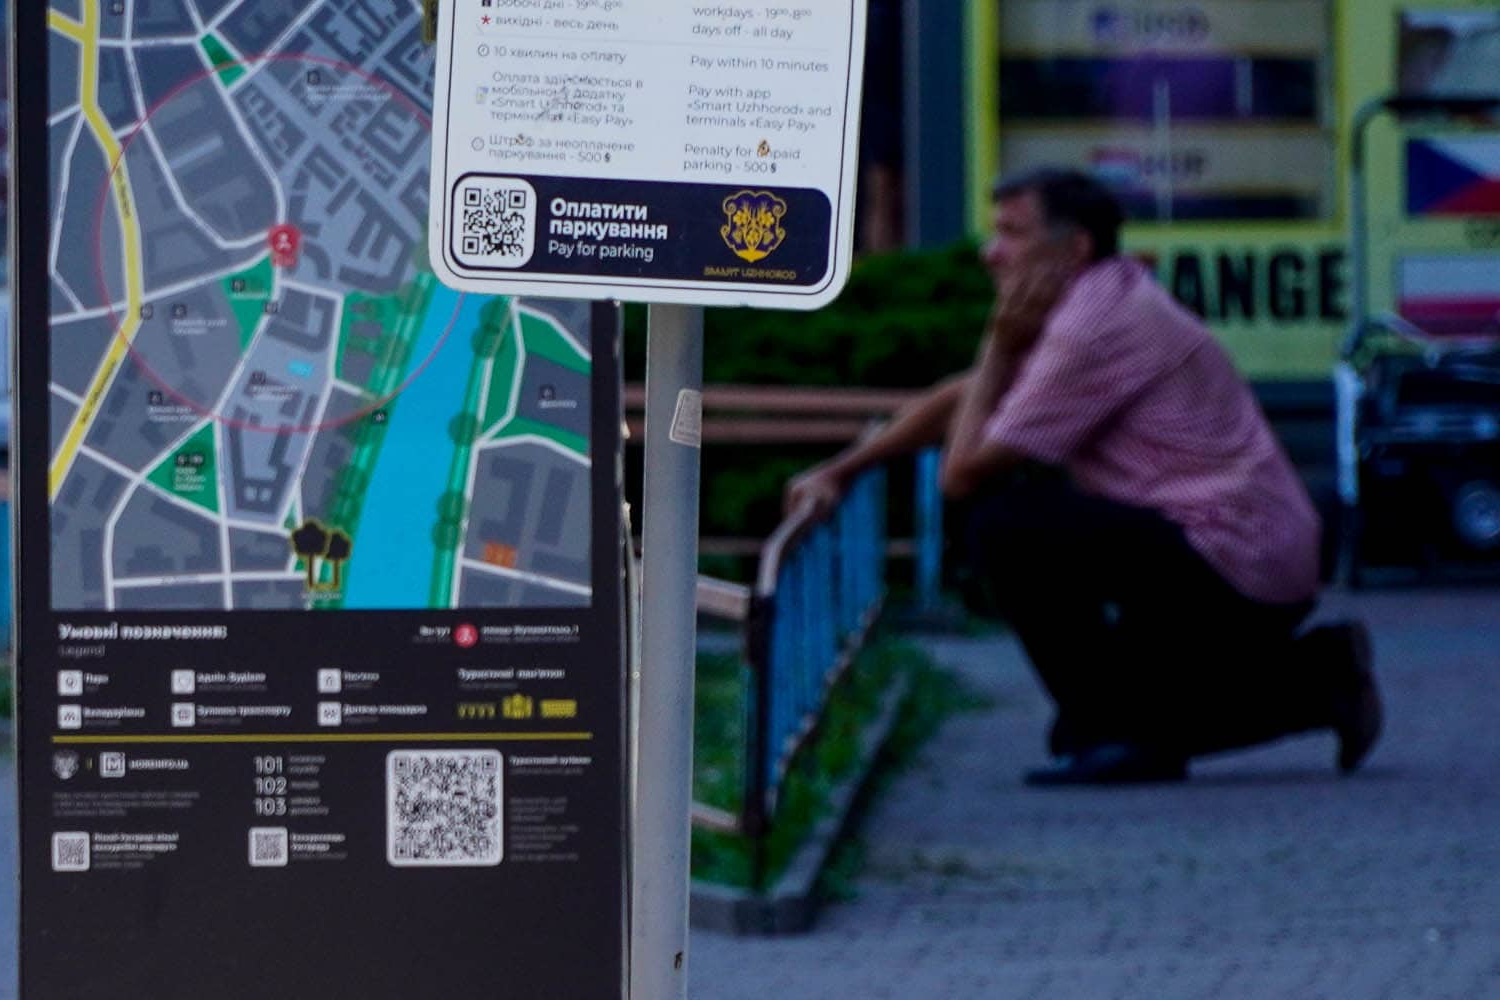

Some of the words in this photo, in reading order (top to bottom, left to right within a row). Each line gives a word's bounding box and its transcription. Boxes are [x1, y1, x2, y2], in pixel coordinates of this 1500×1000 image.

[692, 7, 754, 19] workdays
[554, 19, 583, 29] весь
[692, 23, 721, 37] days
[725, 25, 741, 36] off
[753, 26, 767, 37] all
[771, 28, 794, 41] day
[494, 46, 507, 57] 10
[511, 47, 558, 59] хвилин
[562, 50, 578, 60] на
[581, 51, 627, 64] оплату
[691, 55, 713, 69] Pay
[717, 57, 757, 69] within
[761, 58, 774, 70] 10
[777, 60, 829, 72] minutes
[492, 71, 541, 83] Оплата
[573, 89, 626, 101] додатку
[688, 84, 712, 98] Pay
[715, 87, 743, 98] with
[746, 89, 771, 100] app
[807, 105, 832, 117] and
[686, 113, 746, 128] terminals
[489, 135, 535, 148] Штрф
[556, 140, 635, 151] неоплачене
[488, 149, 566, 162] паркування
[578, 151, 601, 163] 500
[684, 143, 731, 158] Penalty
[735, 145, 752, 157] for
[756, 146, 800, 161] paid
[683, 160, 733, 175] parking
[743, 162, 768, 174] 500
[550, 197, 648, 221] Оплатити
[549, 217, 668, 241] паркування
[548, 240, 572, 258] Pay
[576, 241, 596, 257] for
[599, 243, 654, 262] parking
[1168, 248, 1349, 321] ANGE
[254, 755, 283, 774] 101
[254, 776, 287, 795] 102
[254, 797, 287, 816] 103
